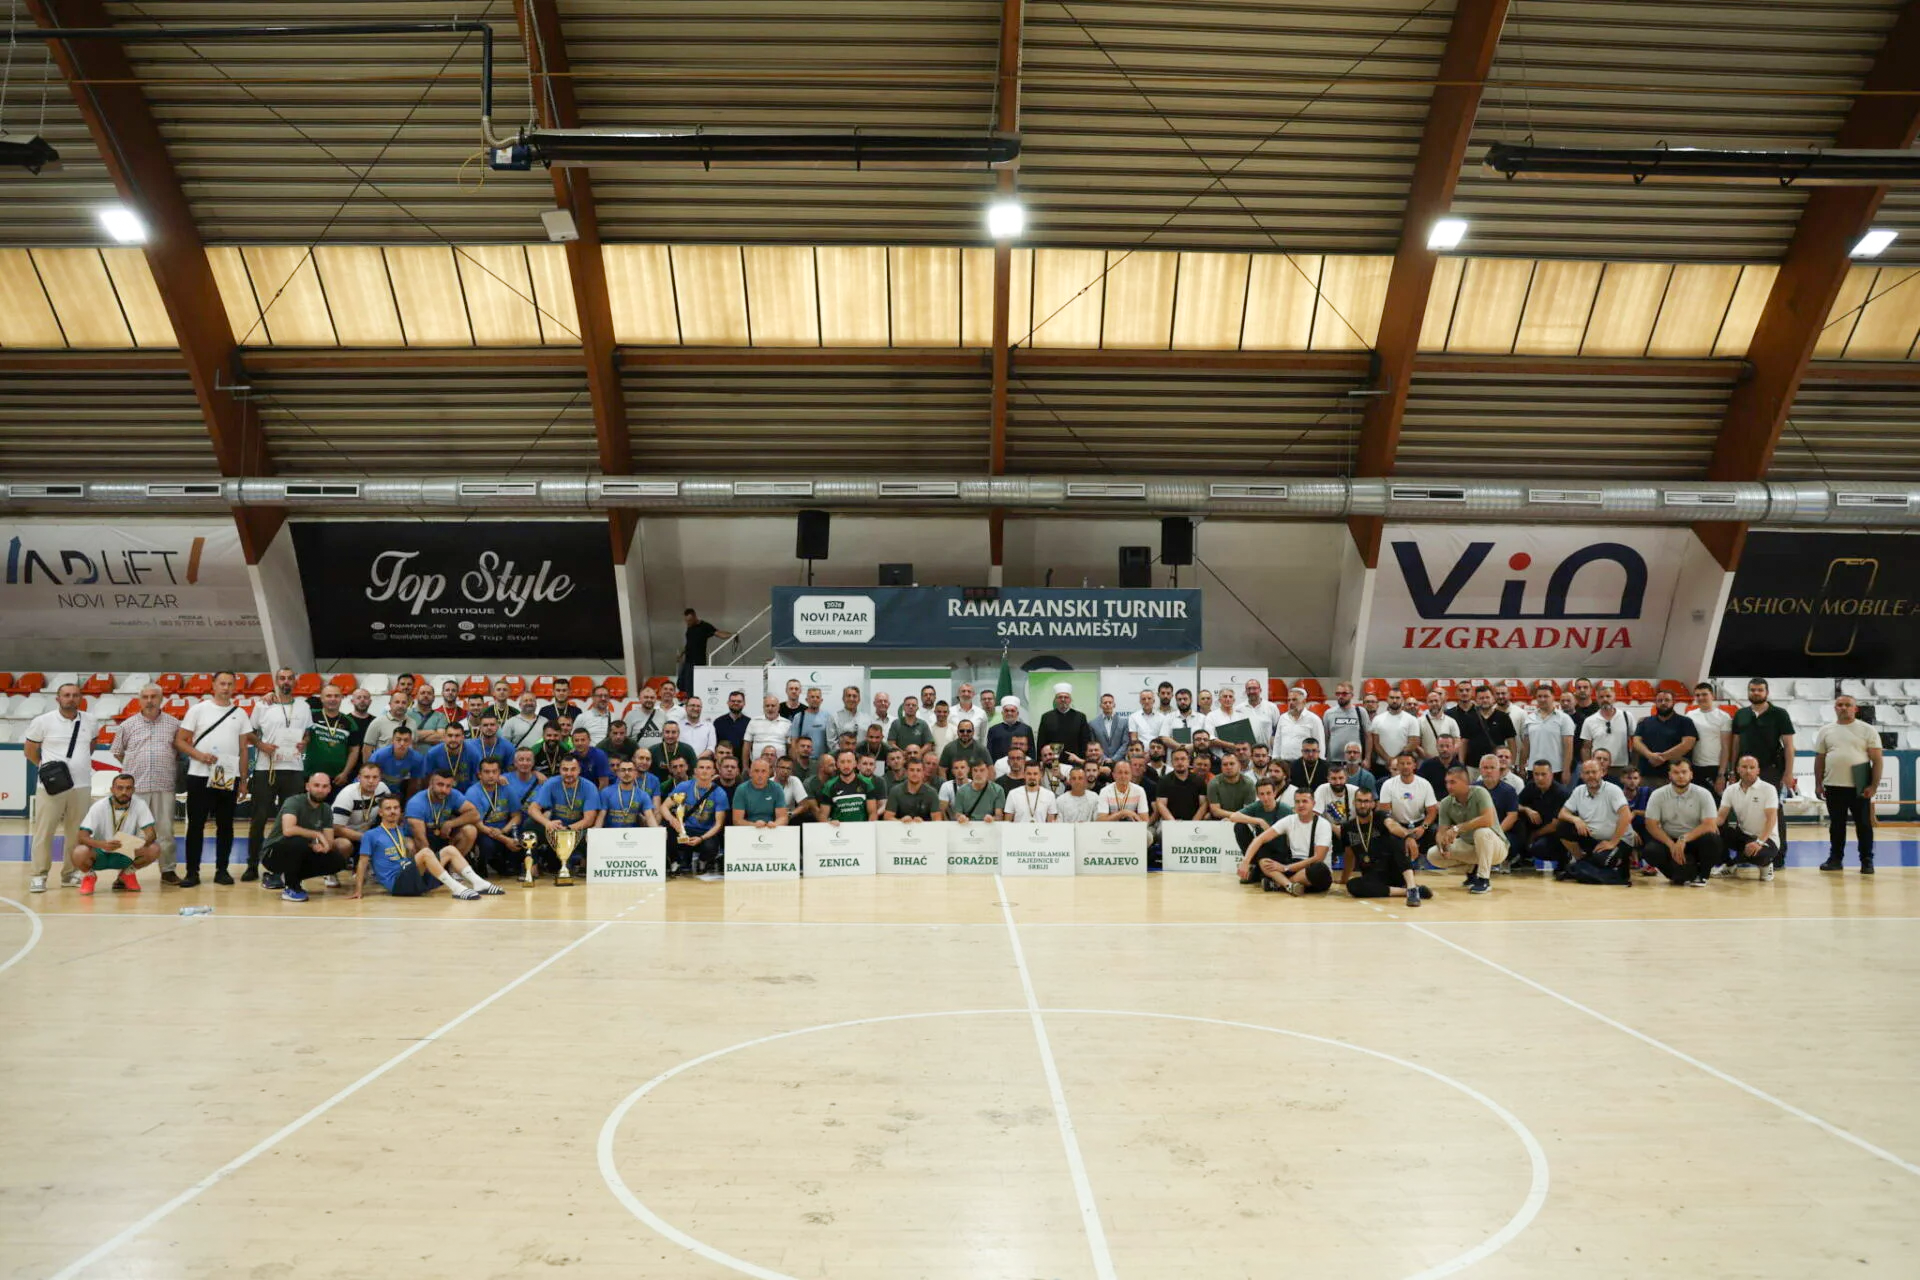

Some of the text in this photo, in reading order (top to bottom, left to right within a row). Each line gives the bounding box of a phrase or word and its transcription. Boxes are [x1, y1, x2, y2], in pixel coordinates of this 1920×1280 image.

[365, 551, 576, 617] Top Style
[58, 593, 179, 608] NOVI PAZAR
[431, 607, 495, 615] BOUTIQUE
[948, 599, 1188, 618] RAMAZANSKI TURNIR
[1727, 597, 1813, 615] ASHION
[1820, 599, 1907, 616] MOBILE
[800, 612, 868, 622] NOVI PAZAR
[997, 619, 1138, 639] SARA NAMEŠTAJ
[1402, 627, 1632, 653] IZGRADNJA
[606, 860, 647, 869] VOJNOG
[819, 857, 860, 868] ZENICA
[947, 854, 999, 865] GORAŽDE
[1083, 856, 1139, 866] SARAJEVO
[1179, 855, 1217, 864] IZ U BIH
[726, 862, 797, 872] BANJA LUKA
[593, 868, 659, 878] MUFTIJSTVA
